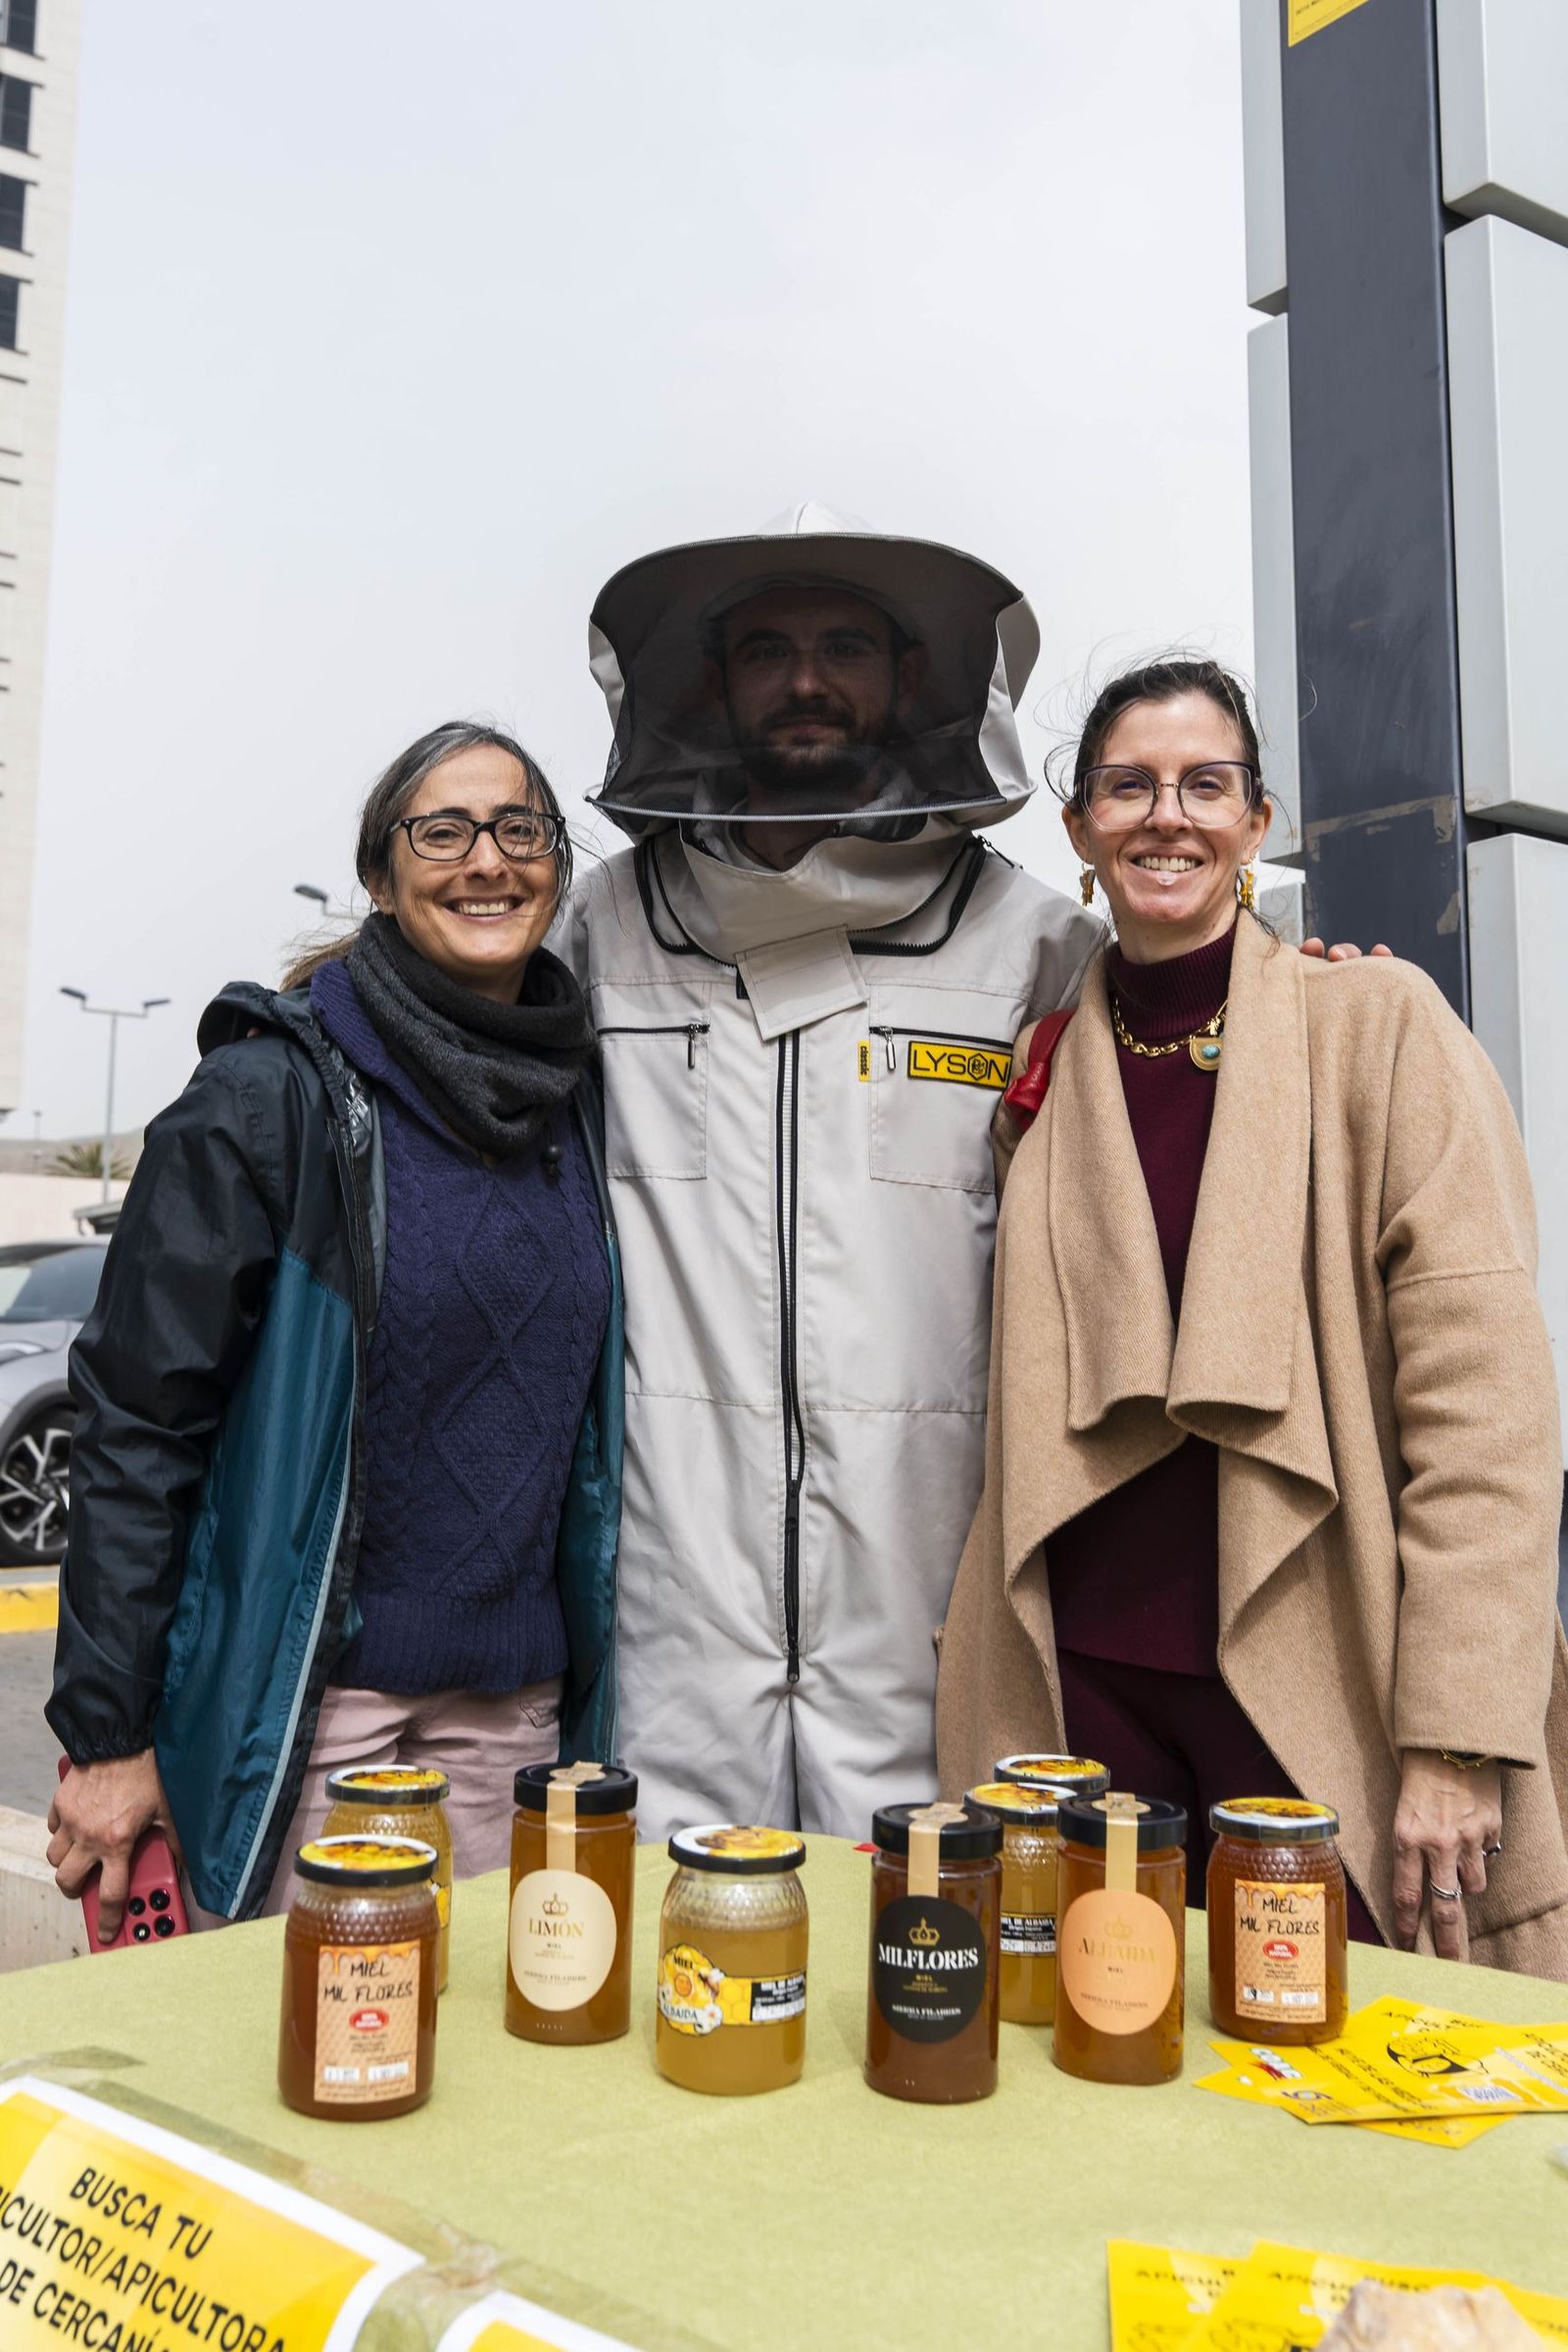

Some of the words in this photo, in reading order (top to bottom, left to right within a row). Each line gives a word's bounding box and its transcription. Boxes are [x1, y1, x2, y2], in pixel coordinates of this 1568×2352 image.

[913, 1050, 1008, 1083] LYSON
[1262, 1897, 1297, 1914] MIEL
[1240, 1915, 1260, 1933] MIL
[1267, 1919, 1320, 1935] FLORES
[673, 1953, 693, 1970] MIEL
[878, 1942, 979, 1970] MILFLORES
[351, 1961, 390, 1978] MIEL
[323, 1984, 348, 2002] MIL
[355, 1979, 413, 2002] FLORES
[70, 2167, 163, 2239] BUSCA
[169, 2214, 214, 2260] TU
[0, 2259, 35, 2305] DE
